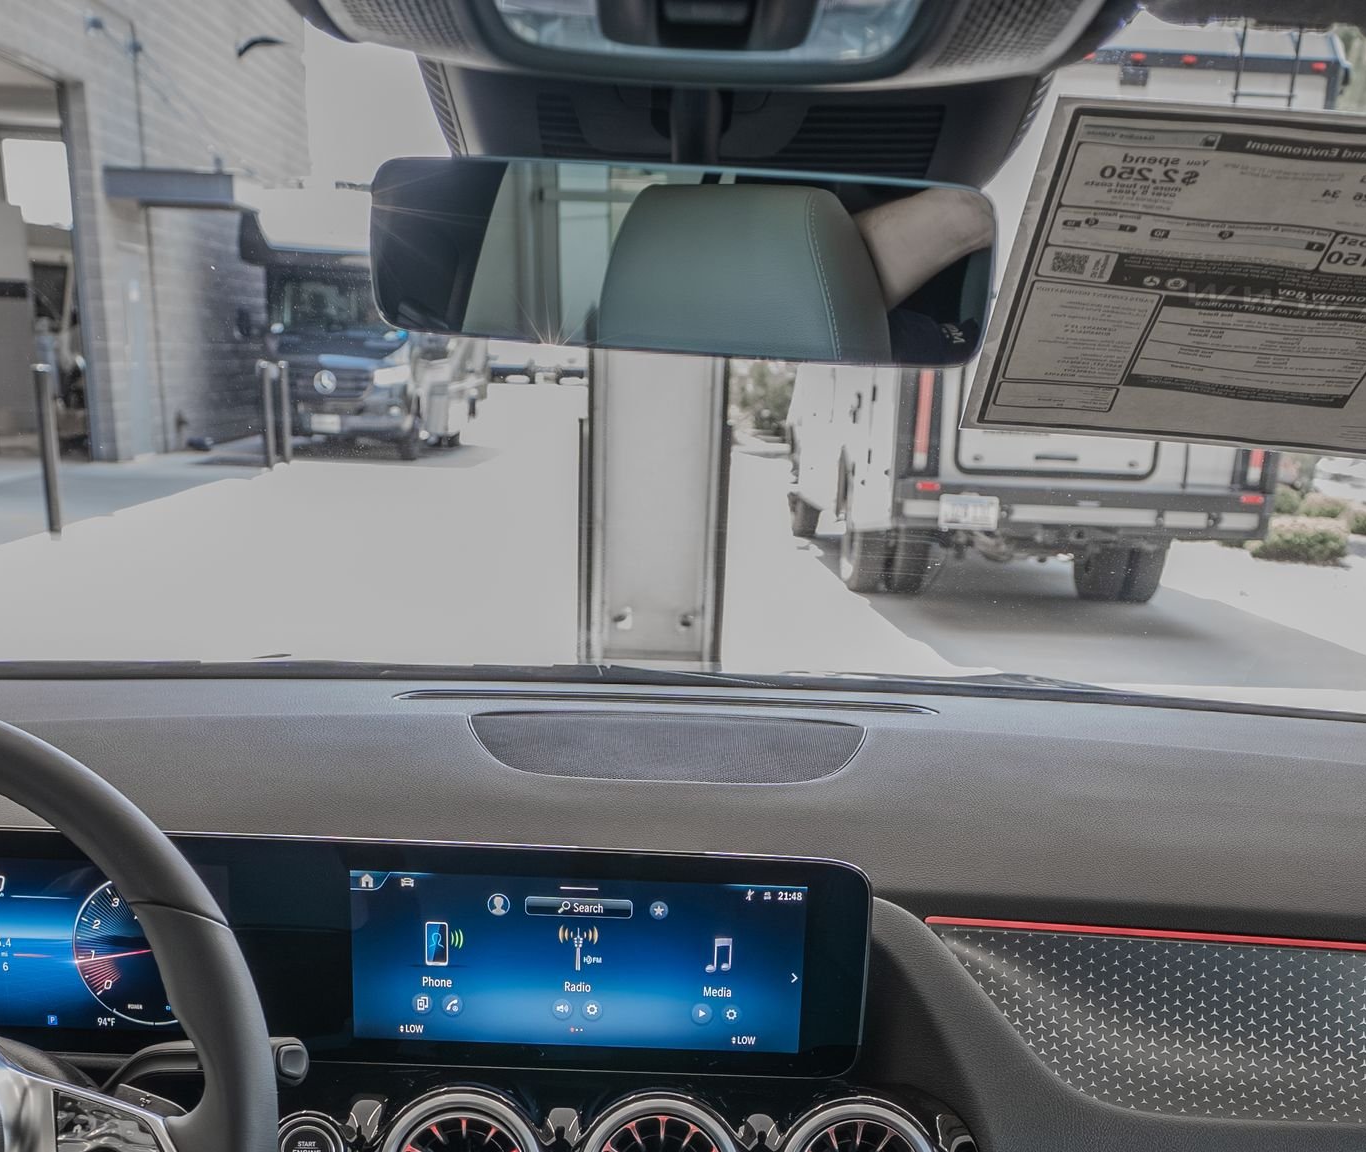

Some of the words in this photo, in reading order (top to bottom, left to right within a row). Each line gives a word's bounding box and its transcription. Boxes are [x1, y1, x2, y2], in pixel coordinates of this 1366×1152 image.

[778, 891, 803, 901] 21:48
[112, 898, 119, 907] 3
[573, 902, 604, 914] Search
[92, 920, 101, 929] 2
[90, 950, 95, 959] 1
[3, 962, 9, 971] 6
[104, 980, 112, 989] 0
[422, 976, 452, 988] Phone
[564, 981, 591, 993] Radio
[703, 986, 732, 998] Media
[97, 1018, 115, 1026] 94°F
[405, 1024, 424, 1033] LOW
[738, 1036, 756, 1045] LOW
